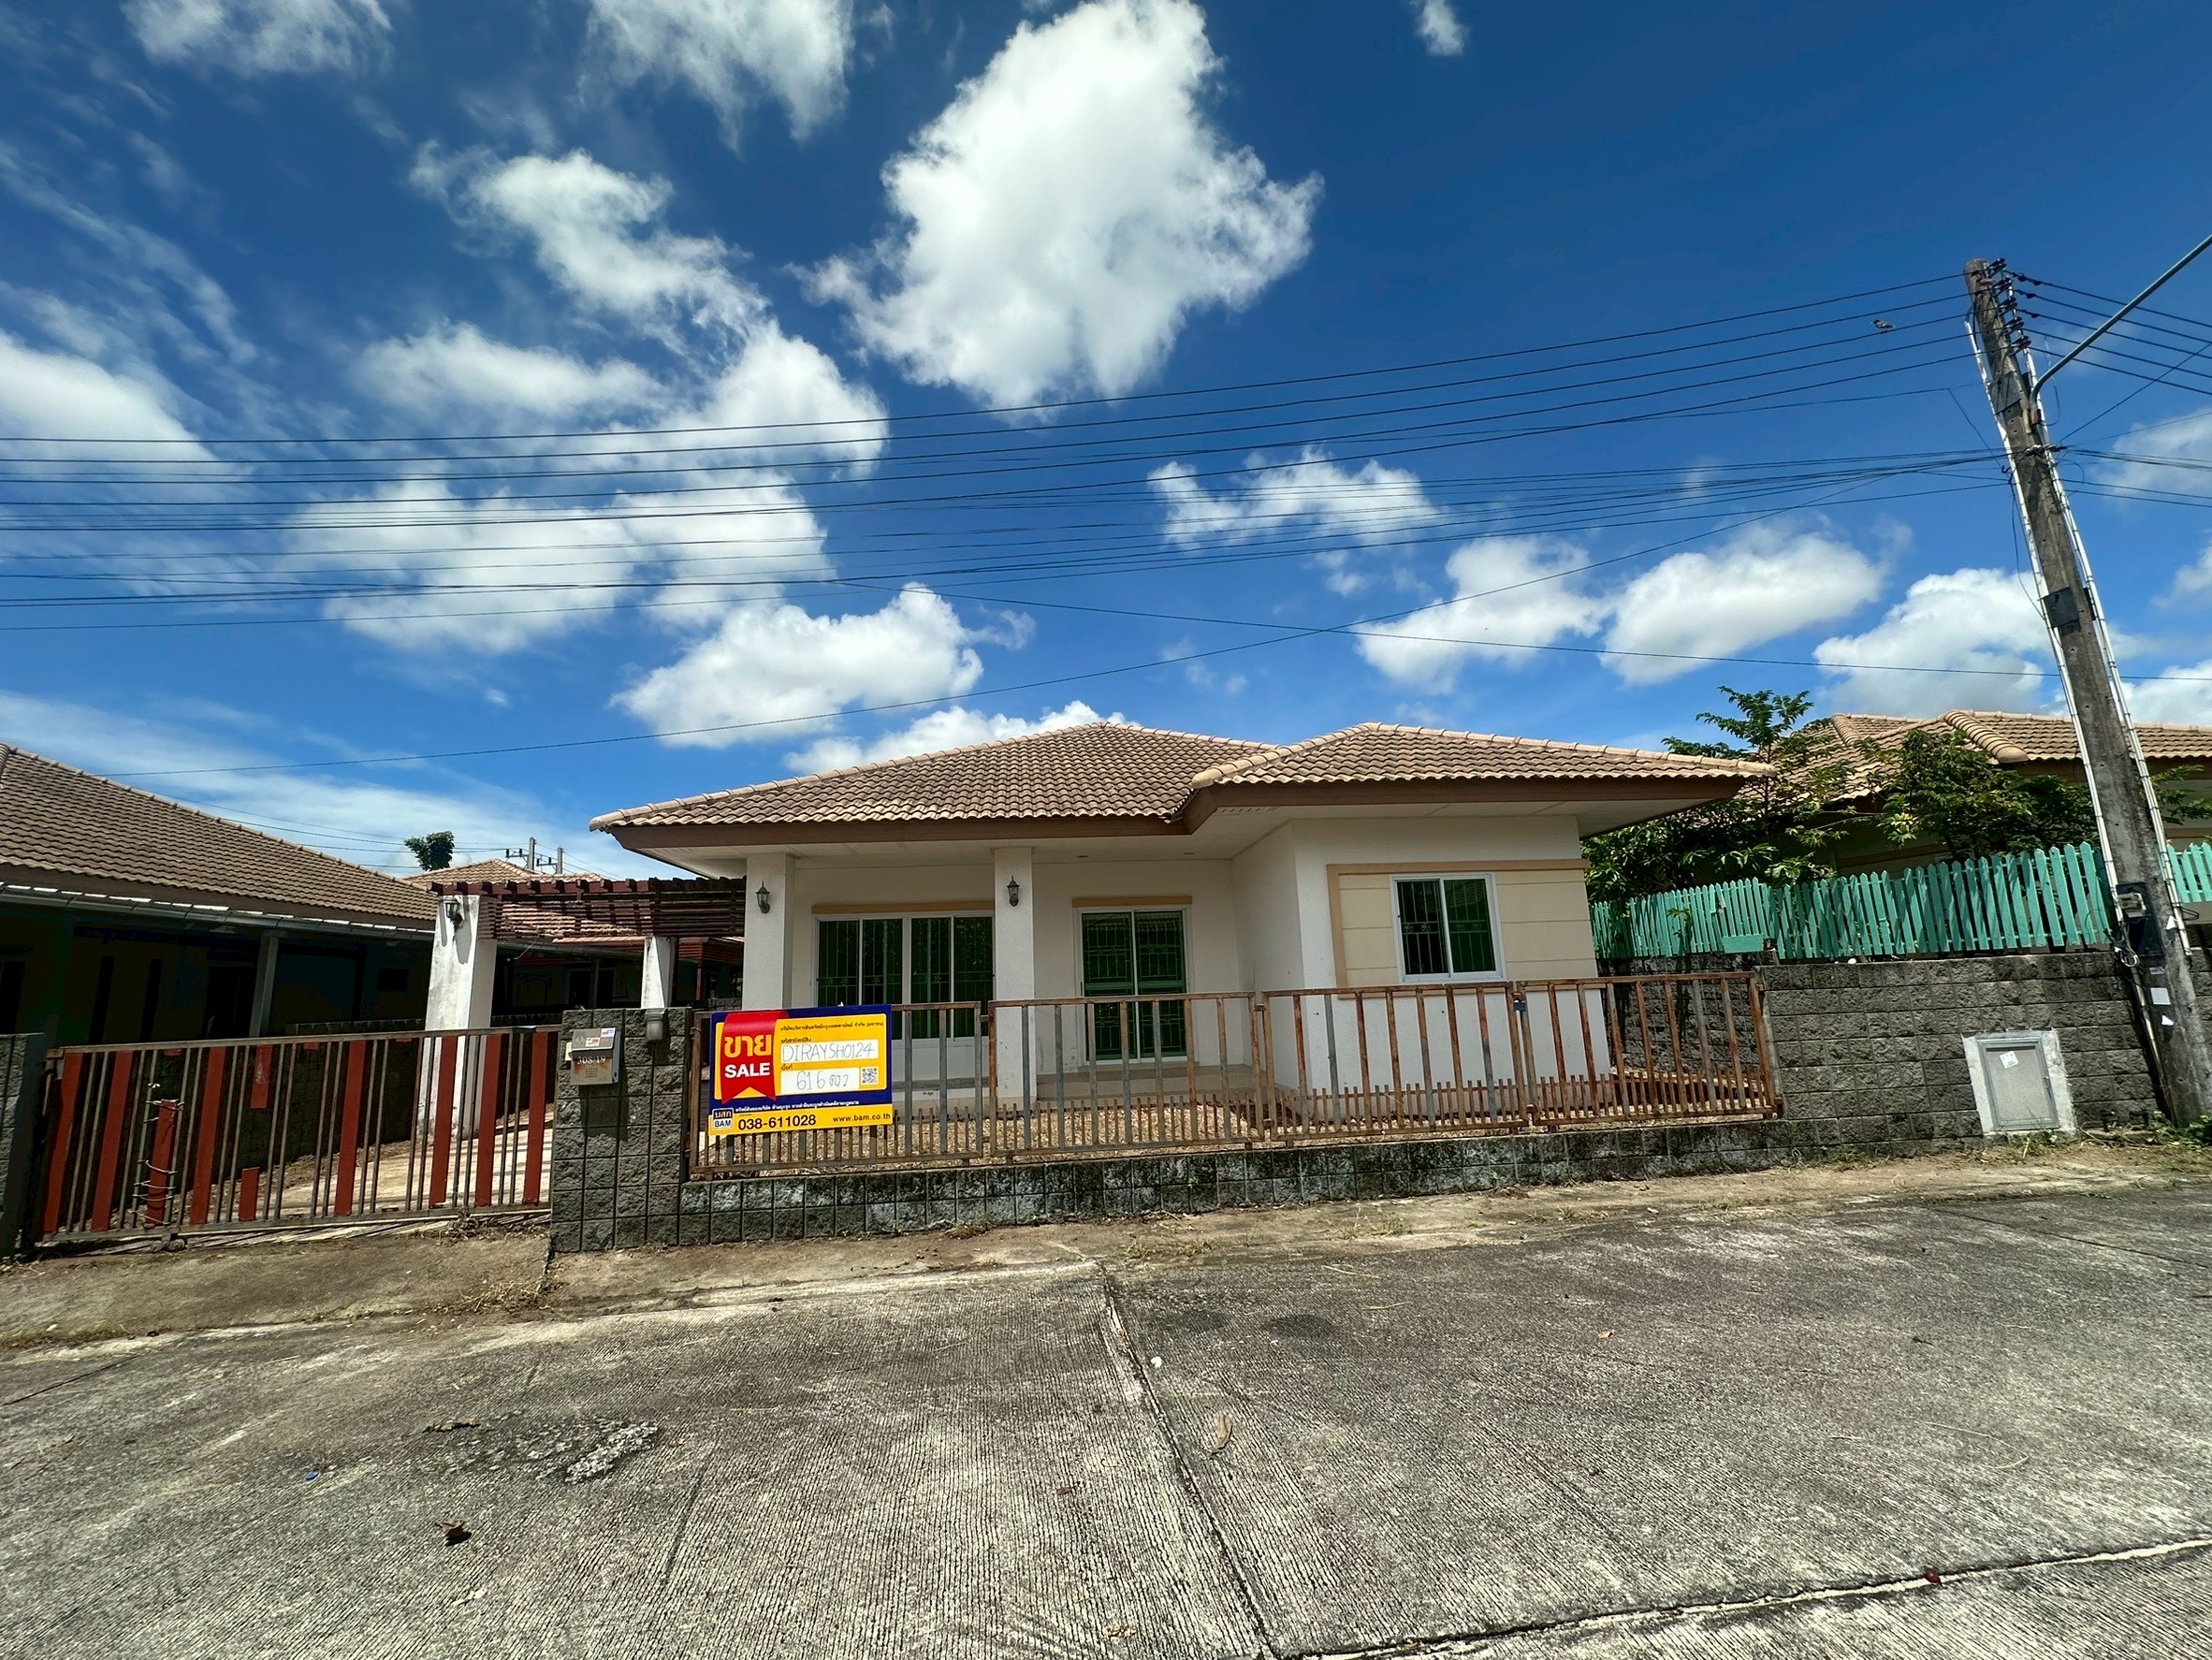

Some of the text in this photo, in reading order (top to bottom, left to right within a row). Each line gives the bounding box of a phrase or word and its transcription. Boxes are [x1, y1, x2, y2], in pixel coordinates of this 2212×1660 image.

[723, 1034, 772, 1058] ขาย
[724, 1062, 771, 1079] SALE
[714, 1119, 732, 1128] BAM
[737, 1113, 891, 1130] 038-611028 www.bam.co.th
